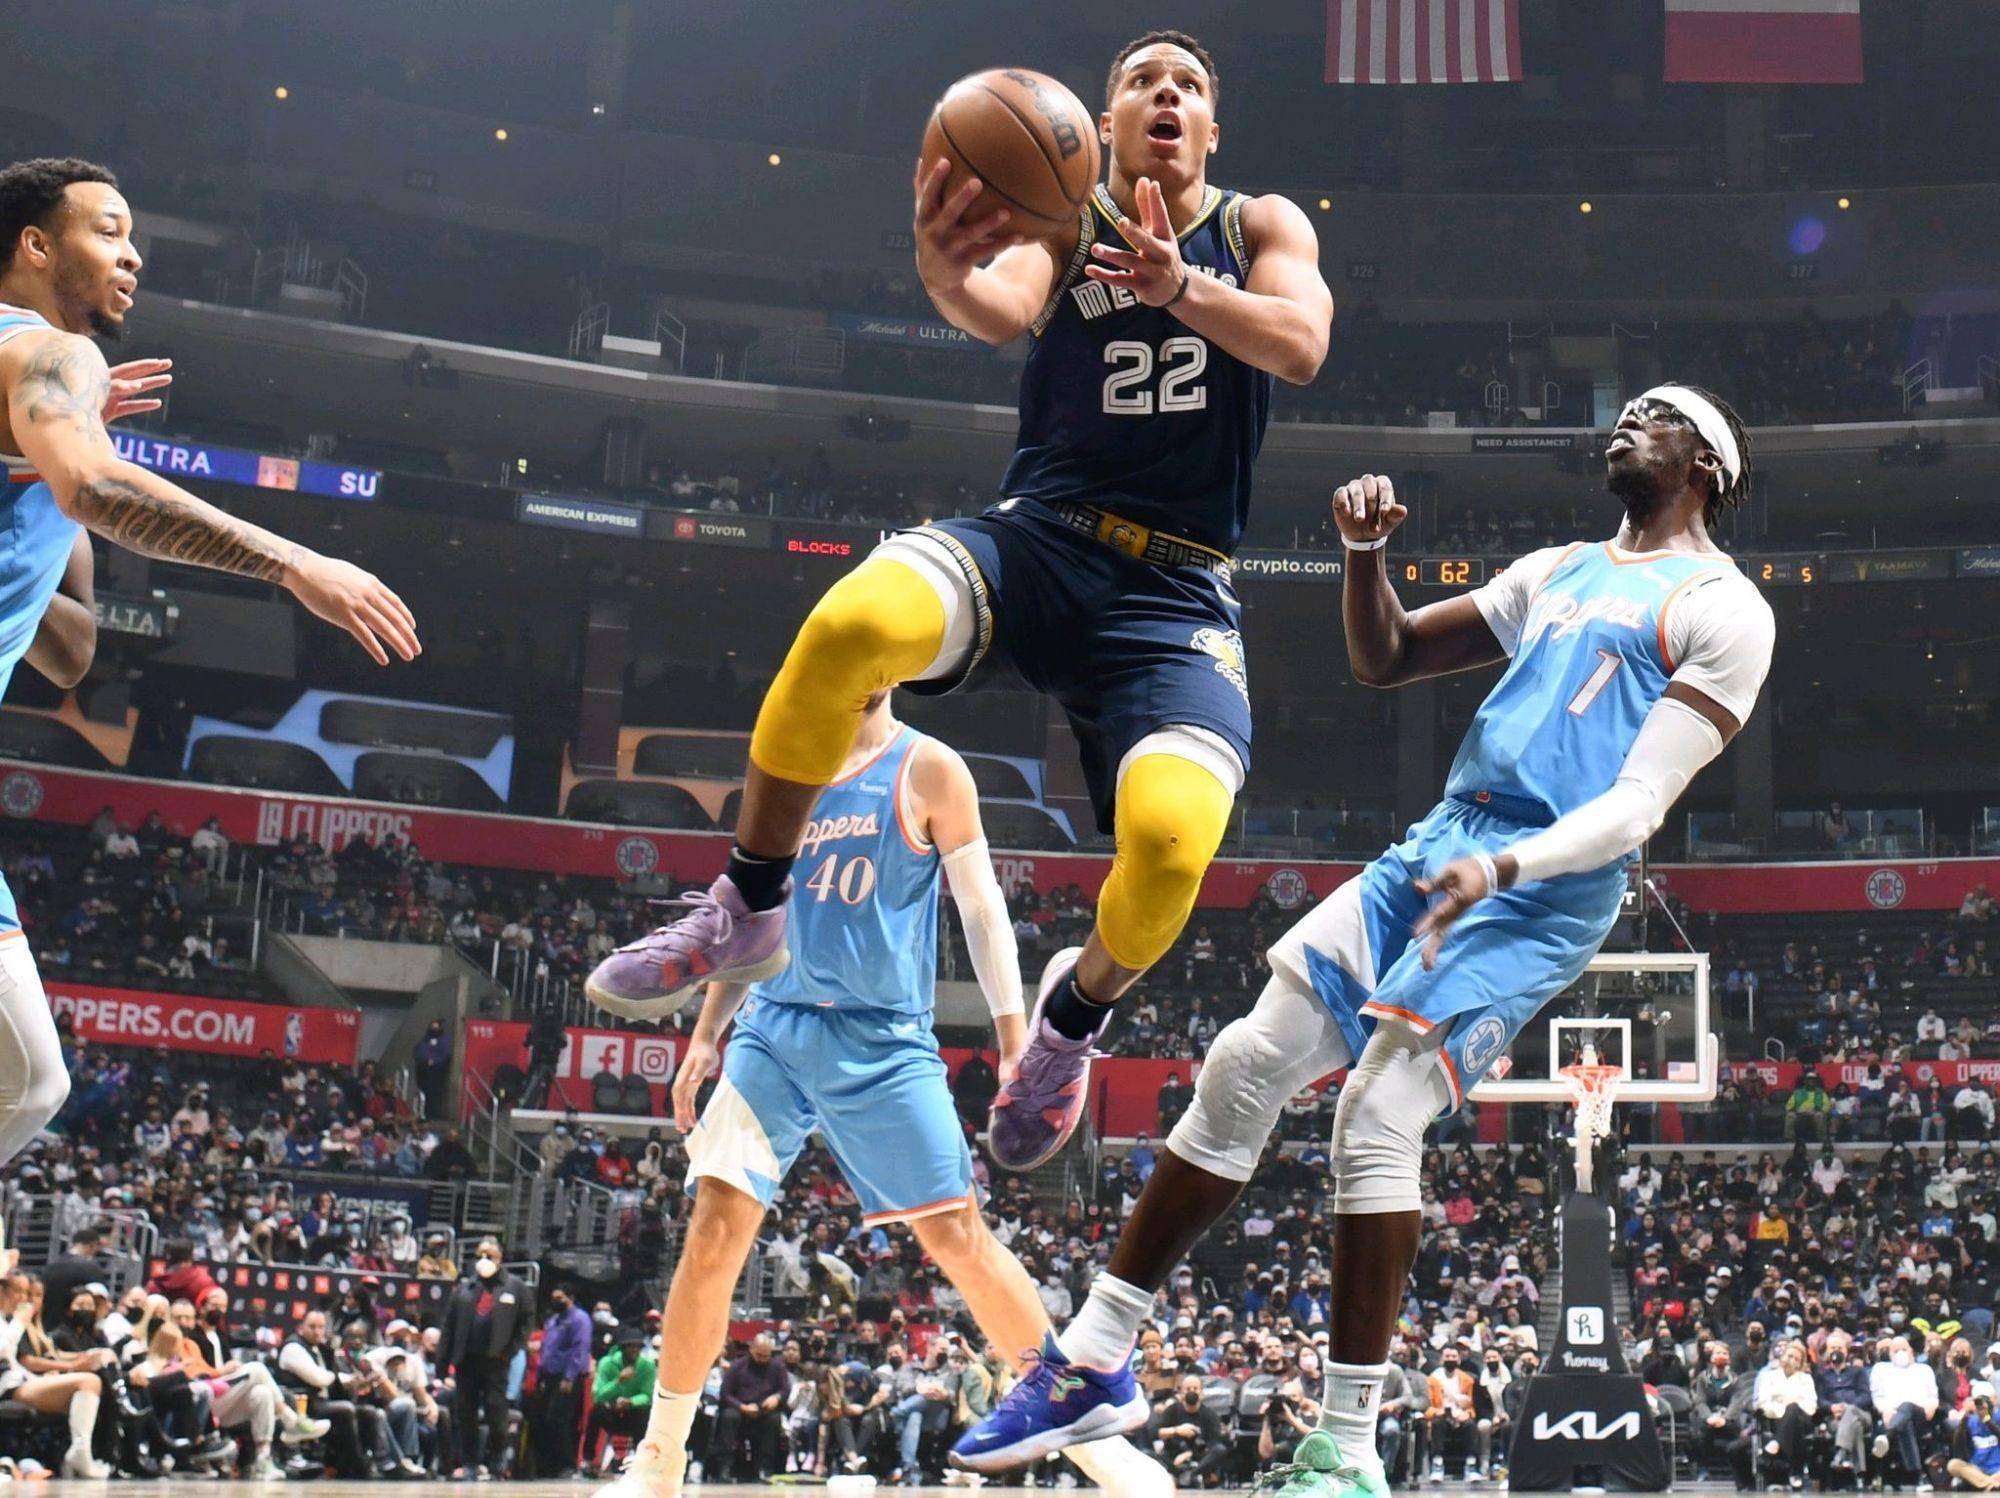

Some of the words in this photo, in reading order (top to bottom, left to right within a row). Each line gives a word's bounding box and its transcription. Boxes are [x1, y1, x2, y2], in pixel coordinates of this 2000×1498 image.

[919, 325, 968, 342] ULTRA
[1102, 336, 1208, 414] 22
[1476, 438, 1503, 447] NEED
[1505, 438, 1572, 447] ASSISTANCE?
[115, 436, 211, 475] ULTRA
[526, 503, 585, 520] AMERICAN
[586, 511, 637, 528] EXPRESS
[700, 524, 746, 538] TOYOTA
[788, 540, 851, 556] BLOCKS
[1242, 557, 1342, 574] crypto.com
[1441, 562, 1470, 583] 62
[1566, 648, 1624, 718] 1
[797, 813, 879, 858] ppers
[806, 853, 876, 905] 40
[1235, 865, 1255, 875] 216
[1918, 865, 1938, 875] 217
[1562, 1351, 1610, 1373] honey
[1533, 1411, 1641, 1440] KIA
